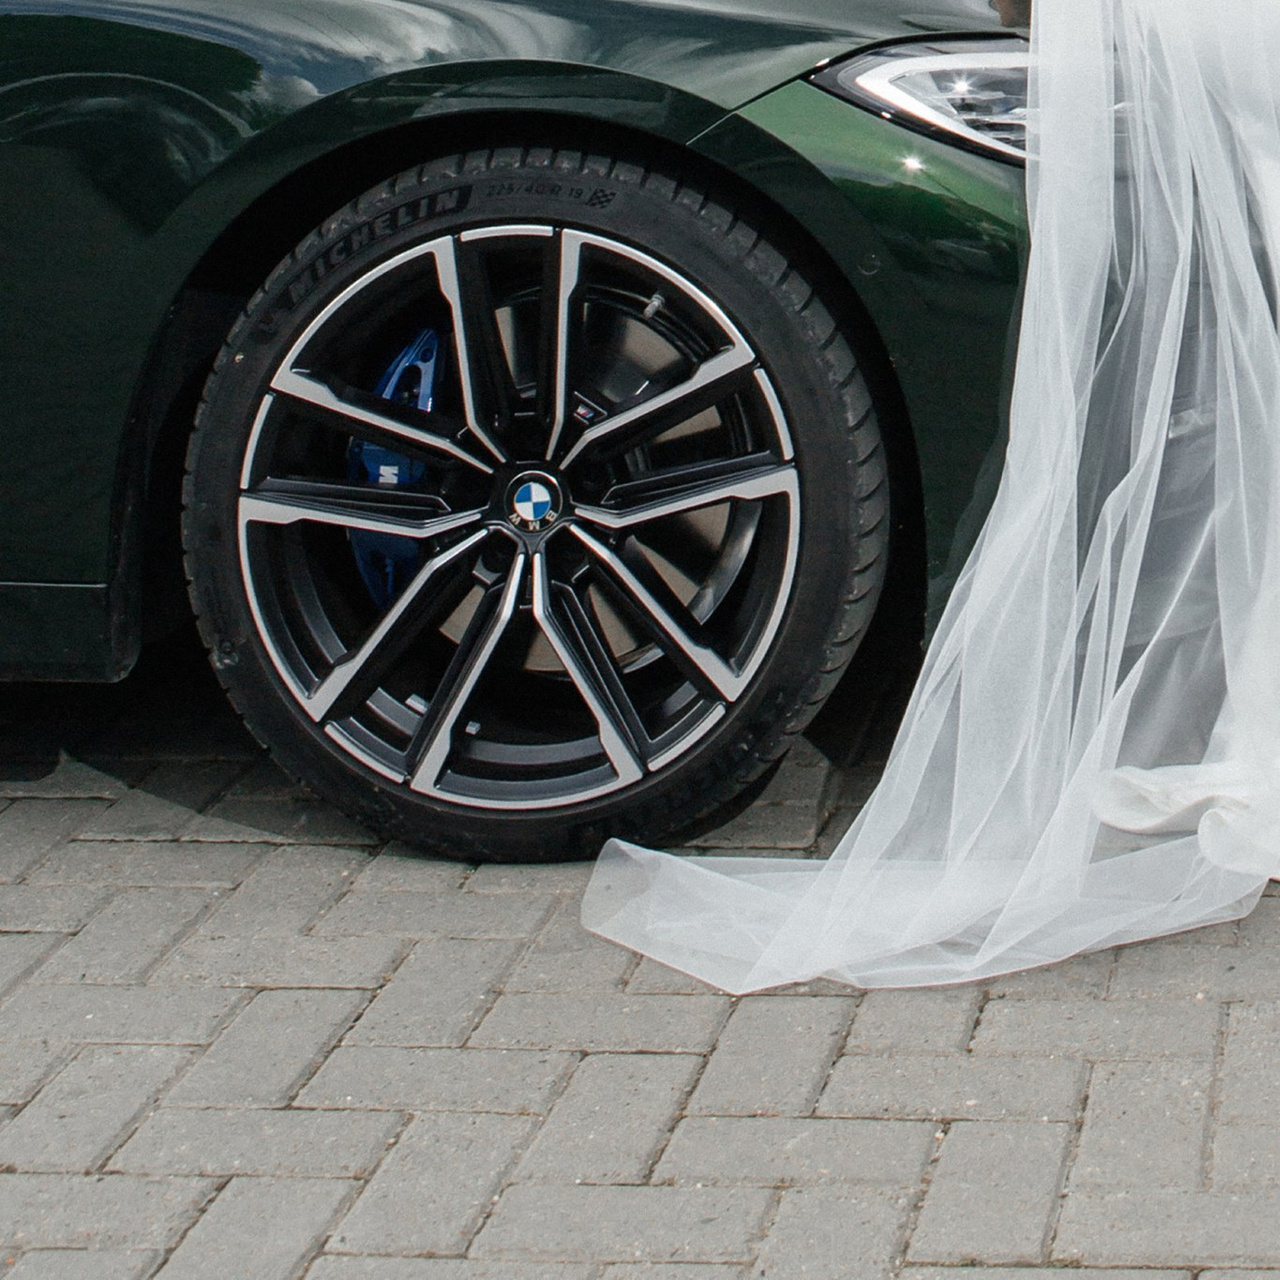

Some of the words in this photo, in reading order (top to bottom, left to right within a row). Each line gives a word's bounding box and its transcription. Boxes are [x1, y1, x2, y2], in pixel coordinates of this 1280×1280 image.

[568, 186, 584, 199] 19
[289, 190, 462, 305] MICHELIN
[508, 509, 558, 531] BMW
